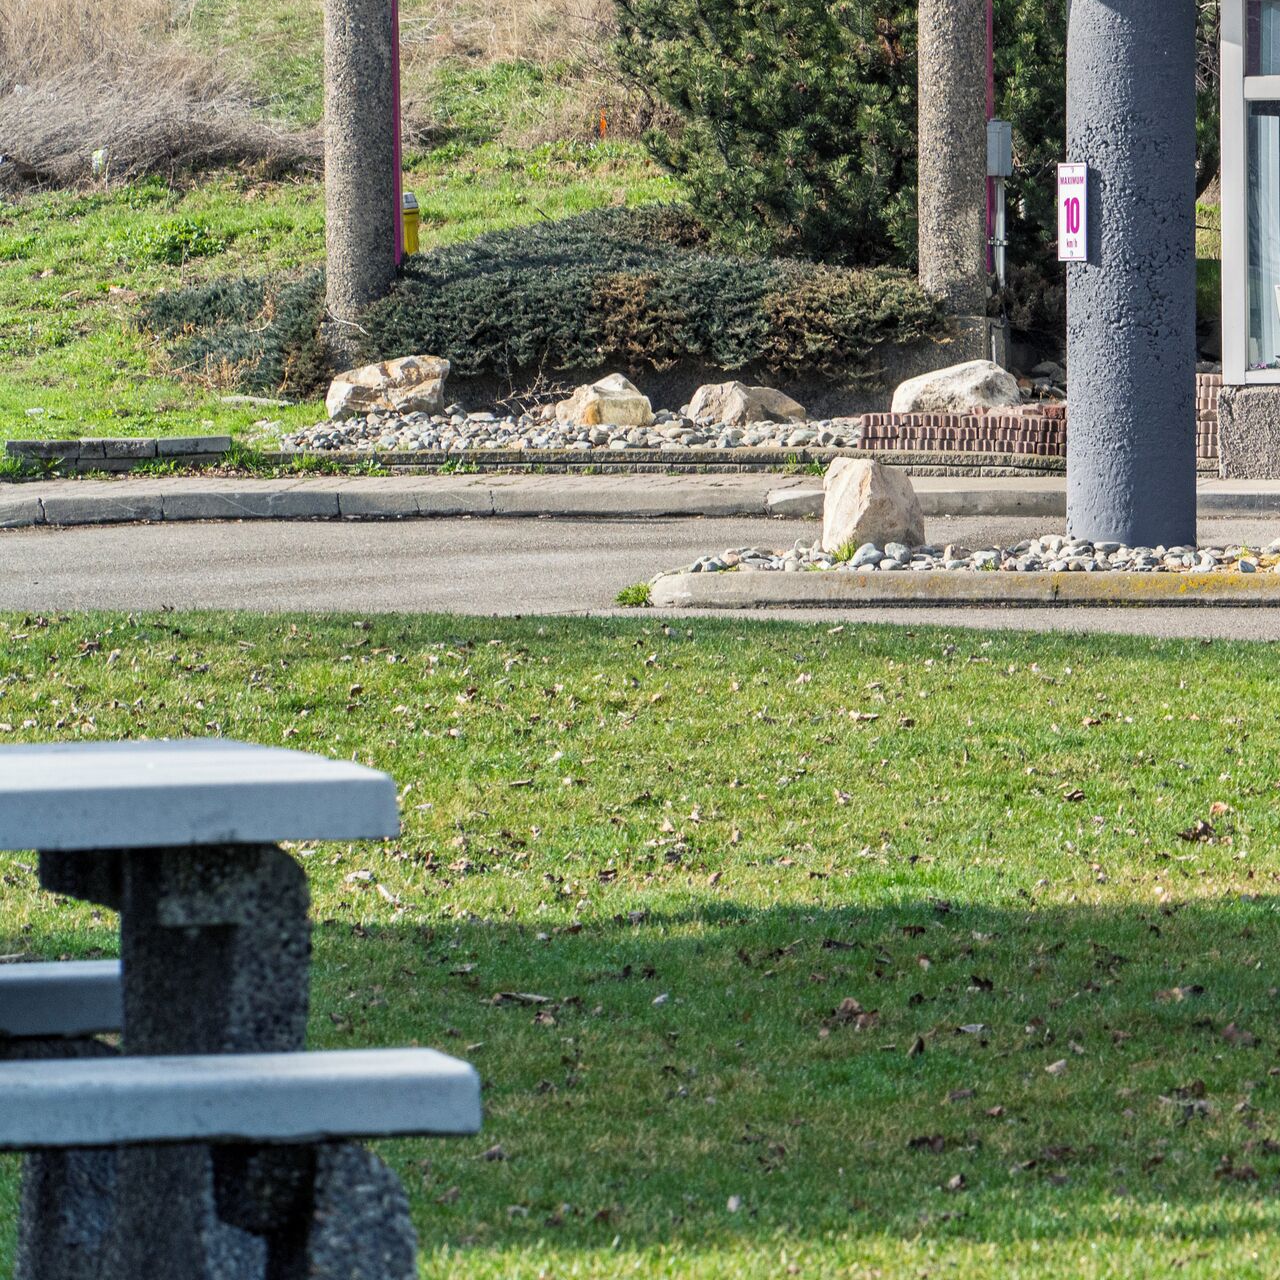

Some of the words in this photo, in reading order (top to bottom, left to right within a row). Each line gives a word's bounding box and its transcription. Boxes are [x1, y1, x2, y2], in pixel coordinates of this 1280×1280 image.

[1060, 176, 1084, 185] MAXIMUM
[1064, 197, 1080, 234] 10
[1066, 238, 1078, 248] kmh
